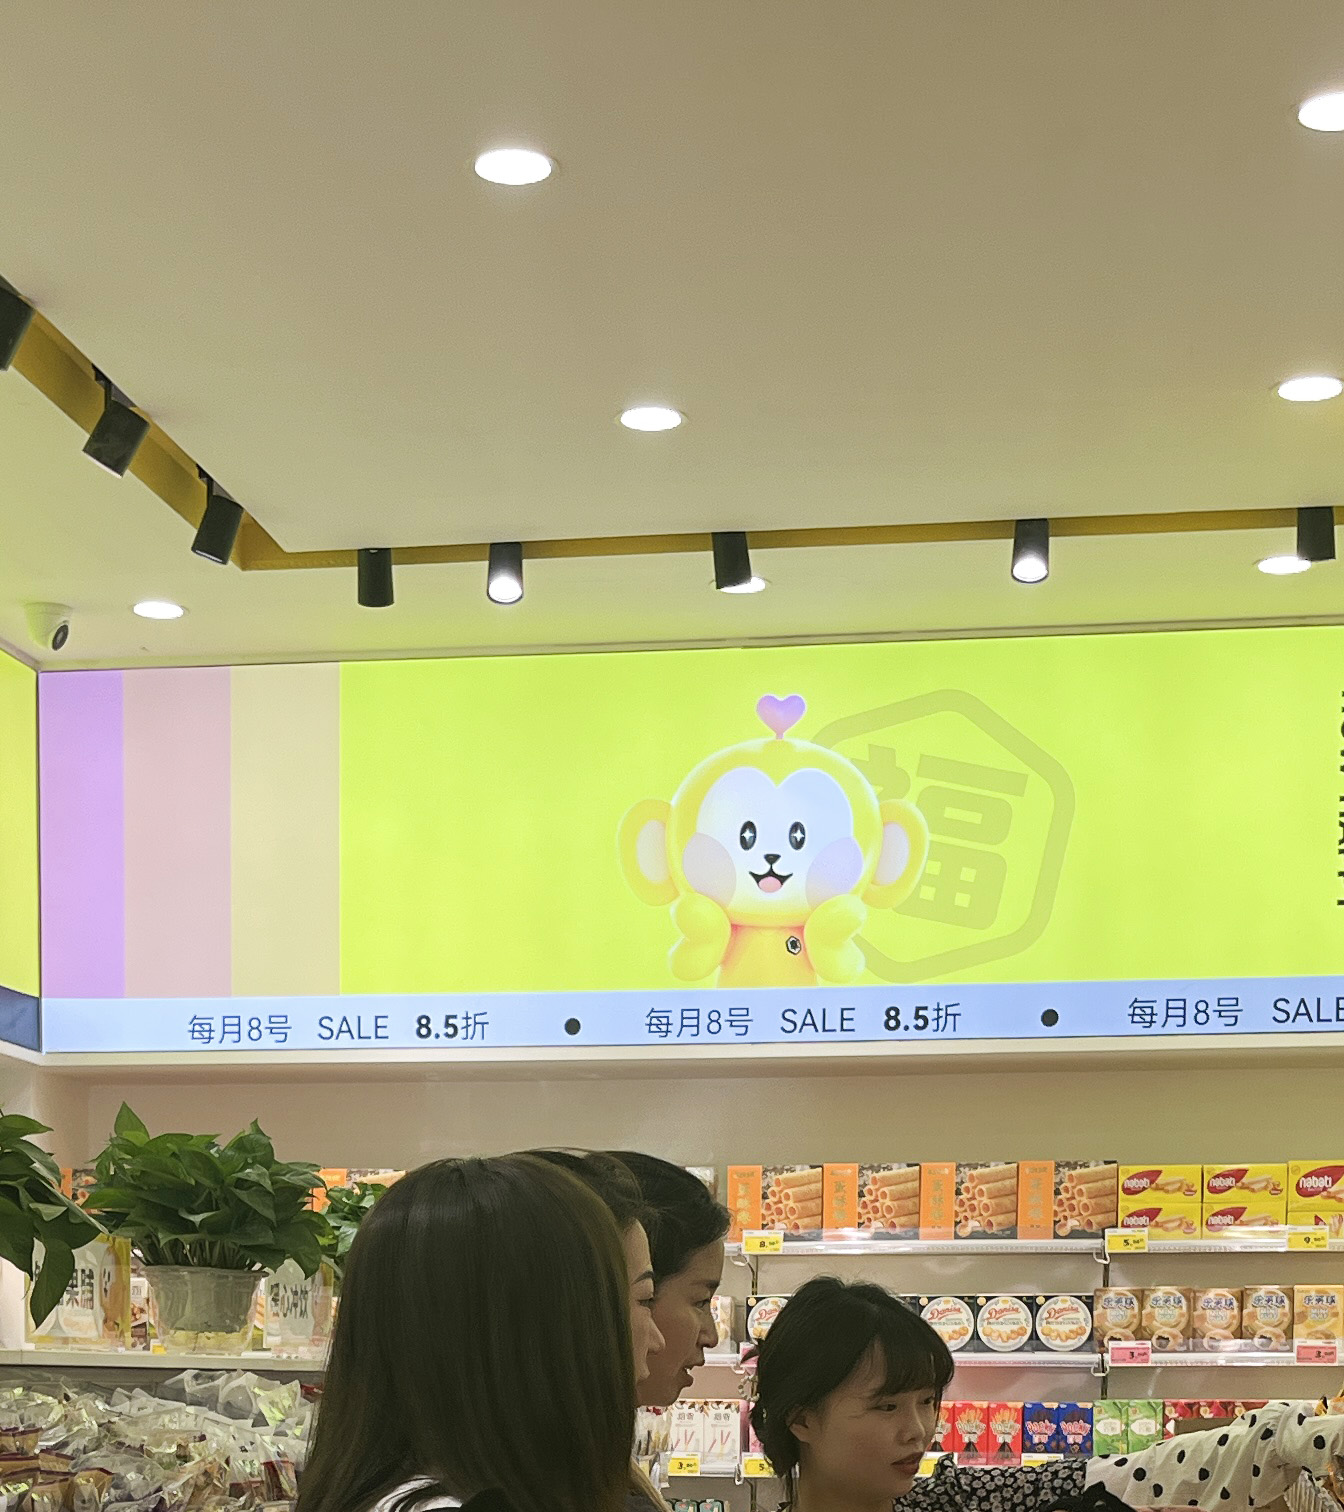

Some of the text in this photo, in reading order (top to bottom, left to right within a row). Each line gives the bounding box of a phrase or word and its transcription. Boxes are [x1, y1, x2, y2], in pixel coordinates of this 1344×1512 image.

[187, 1011, 490, 1046] 每月8号 SALE 8.5折
[644, 1001, 963, 1040] 每月8号 SALE 8.5折
[1127, 996, 1244, 1030] 每月8号
